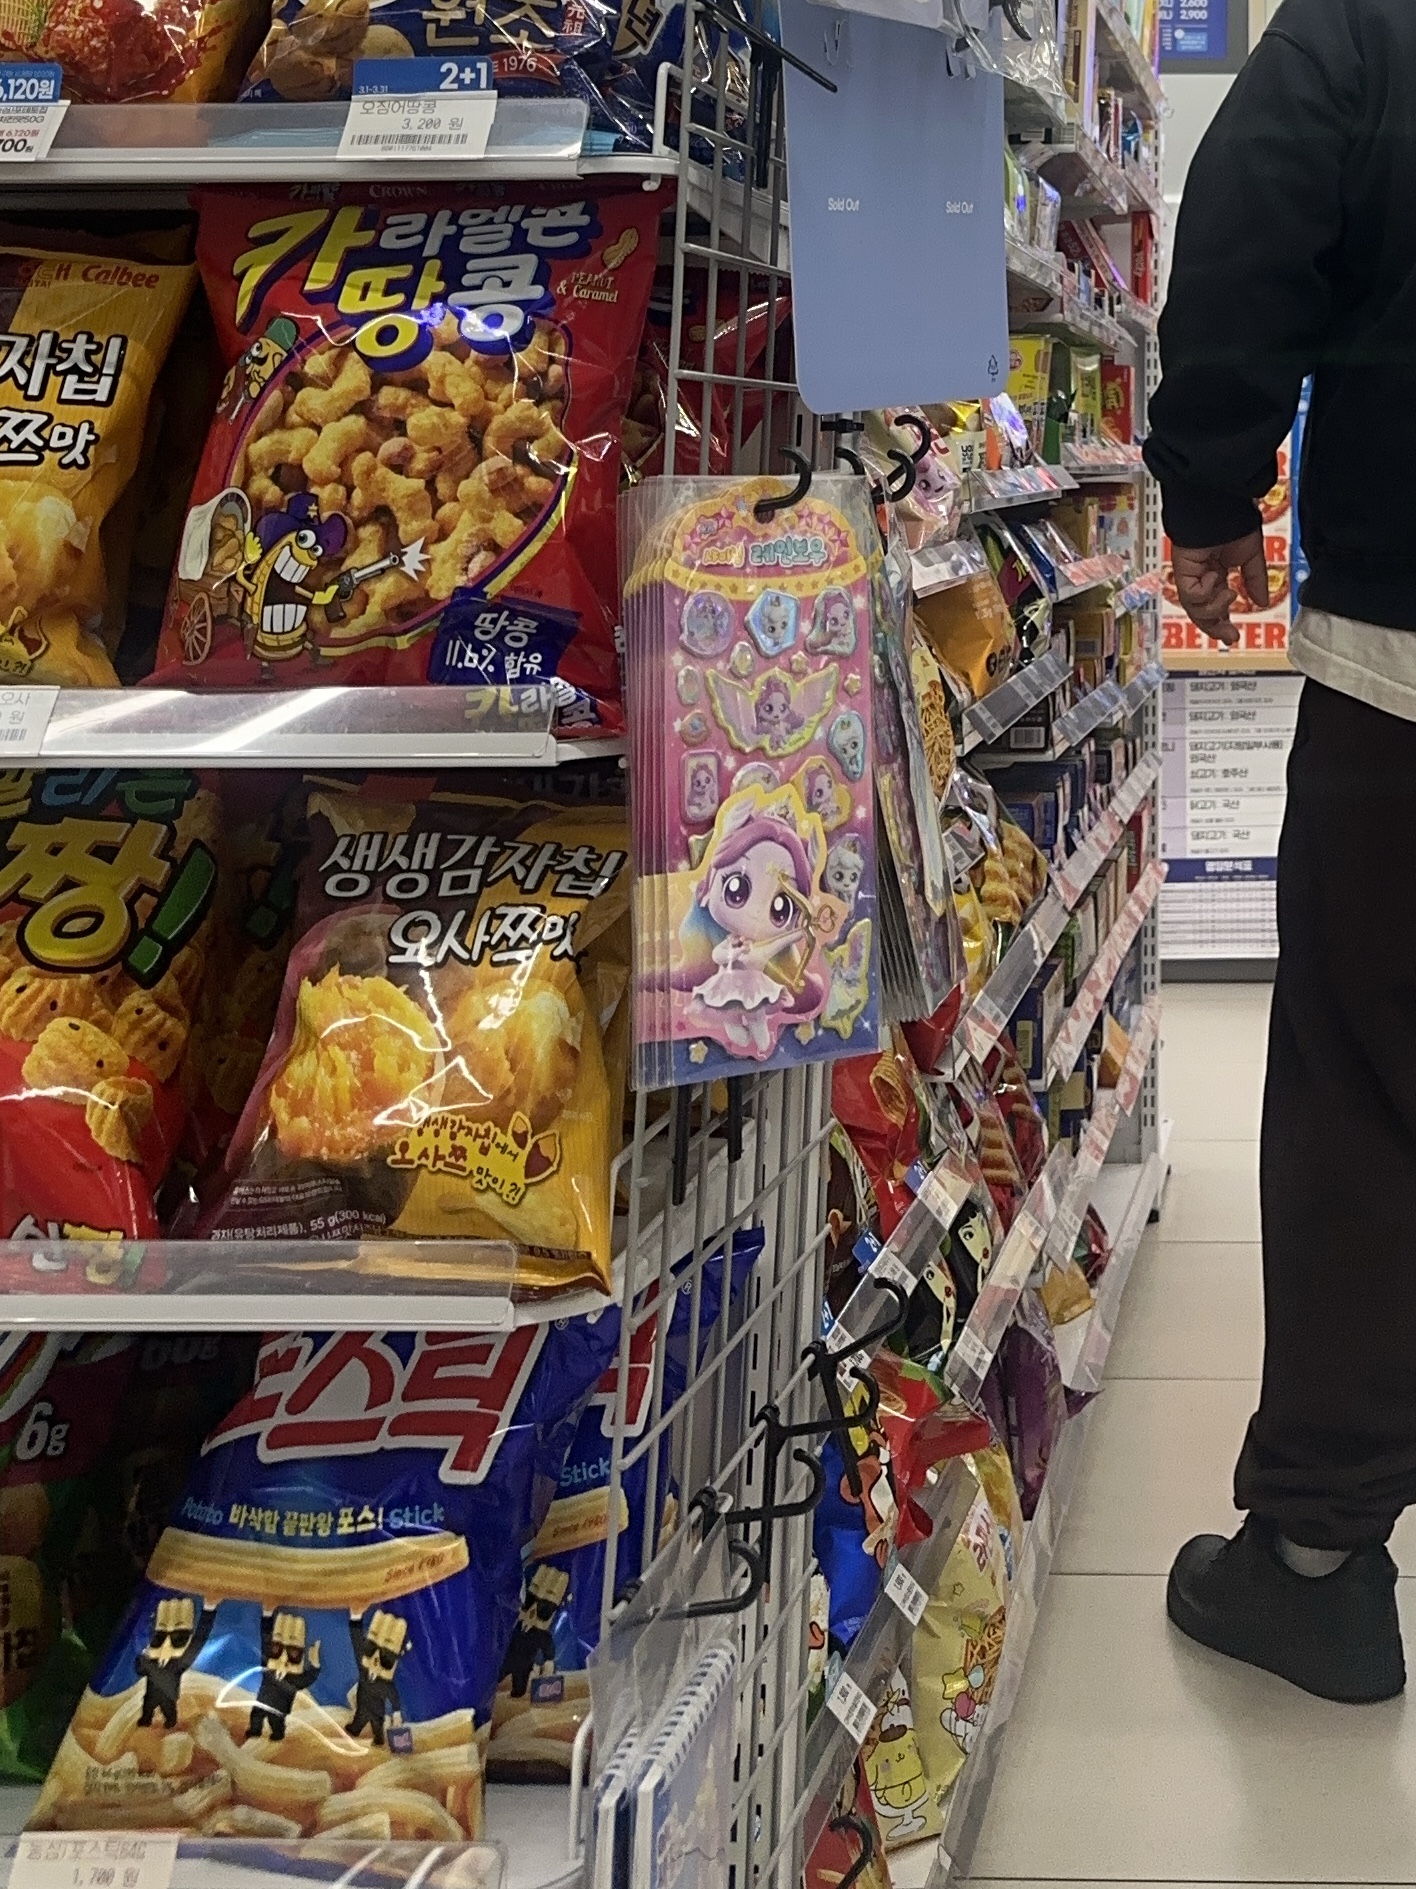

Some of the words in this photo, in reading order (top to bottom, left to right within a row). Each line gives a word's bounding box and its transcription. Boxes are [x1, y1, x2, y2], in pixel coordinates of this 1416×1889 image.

[439, 61, 488, 91] 2+1
[502, 56, 538, 73] 1976
[360, 100, 438, 115] 오징어땅콩
[401, 117, 442, 131] 3,200
[448, 117, 465, 131] 원
[81, 264, 160, 289] Calbee
[336, 253, 546, 359] 땅콩
[572, 284, 620, 304] Caramel
[749, 537, 829, 568] 레인보우
[474, 609, 540, 649] 땅콩
[1161, 622, 1287, 652] BETER
[318, 831, 623, 900] 생생감자칩
[387, 904, 579, 964] 오사쯔맛
[389, 1502, 445, 1530] Stick
